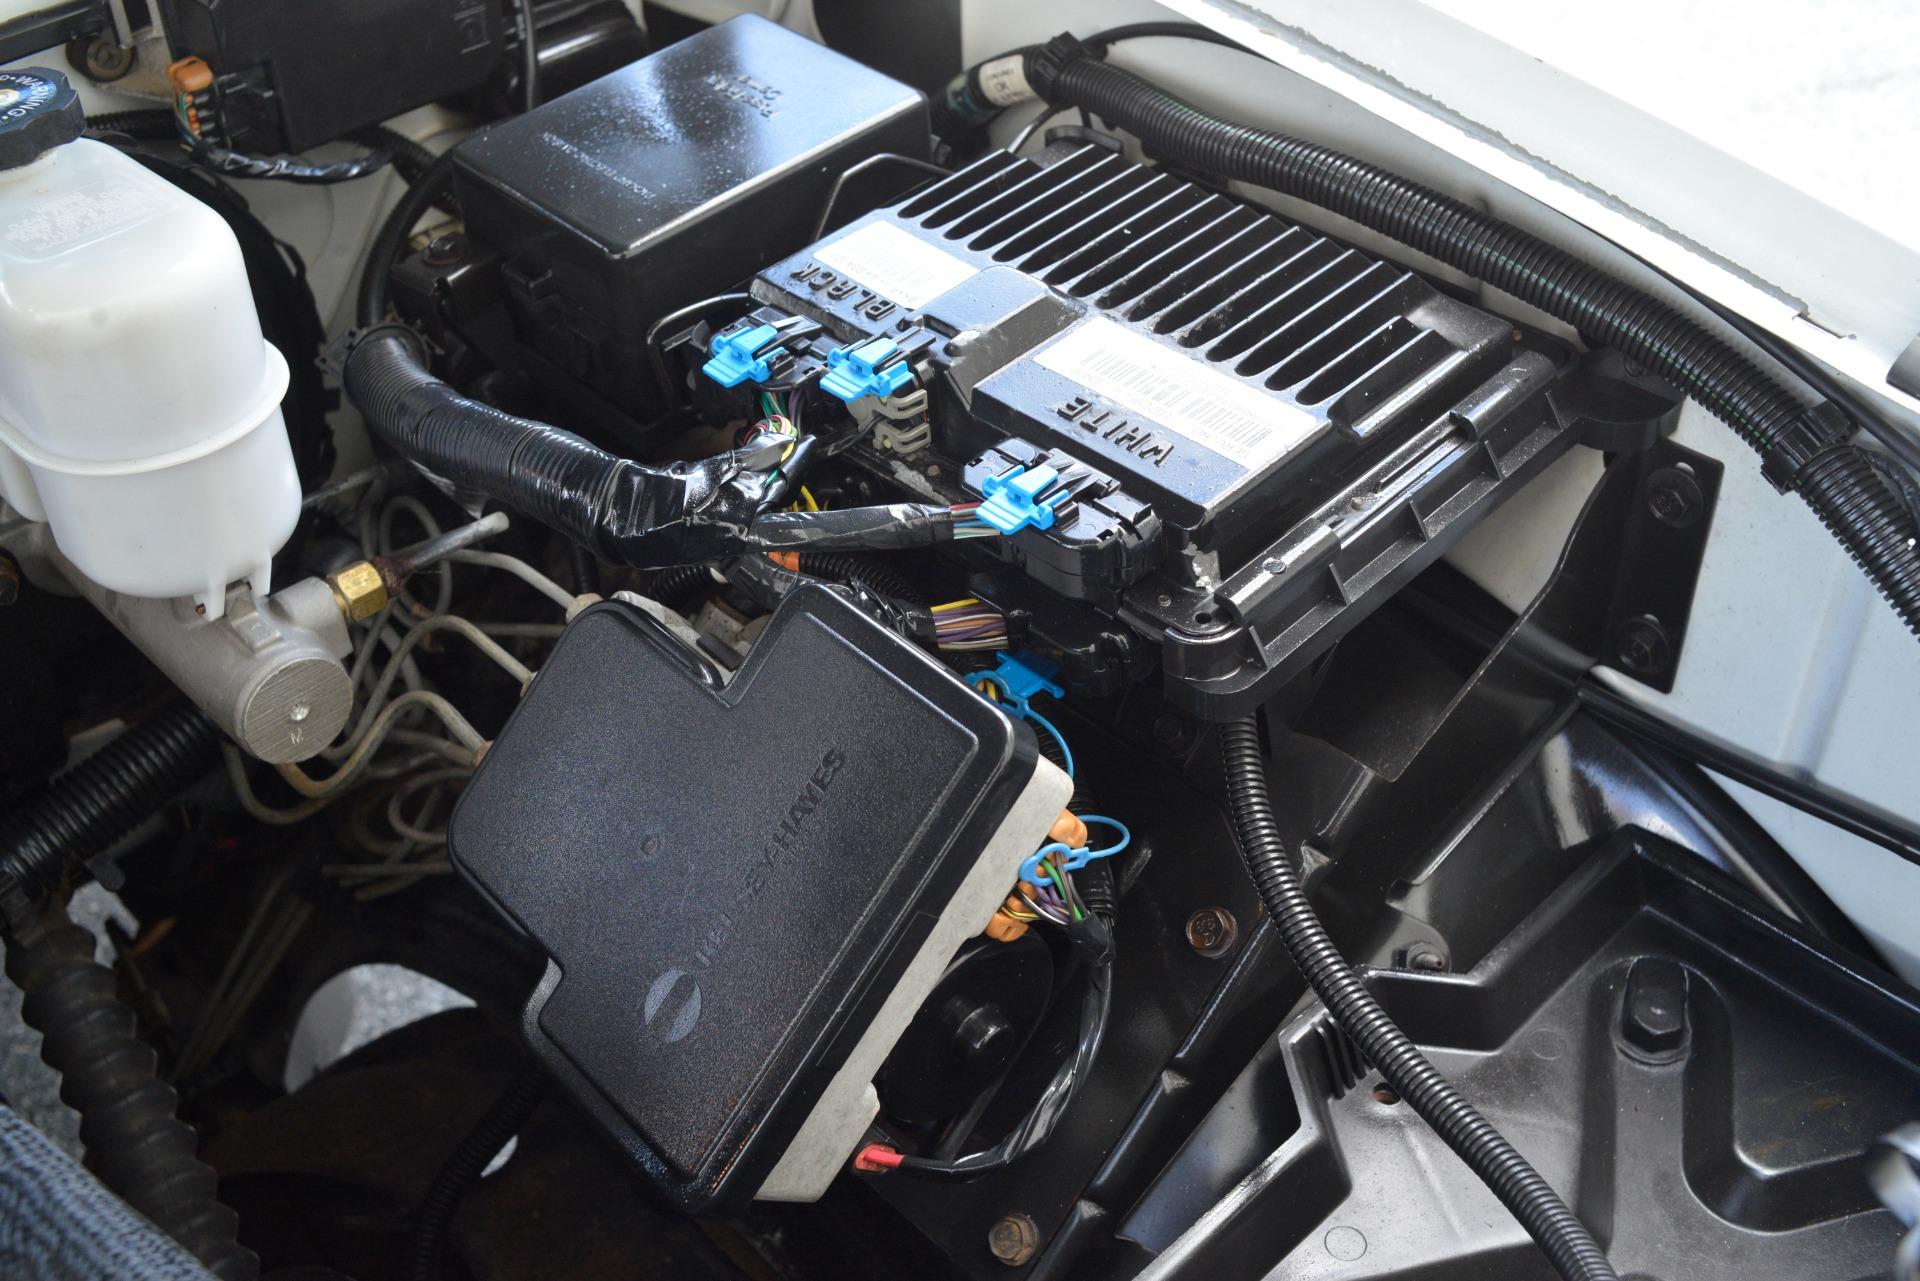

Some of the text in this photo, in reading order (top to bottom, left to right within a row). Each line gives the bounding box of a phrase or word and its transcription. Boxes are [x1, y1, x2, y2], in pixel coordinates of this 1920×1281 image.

[8, 75, 48, 117] WARNING
[790, 264, 897, 321] BLACK
[1056, 397, 1175, 468] WHITE
